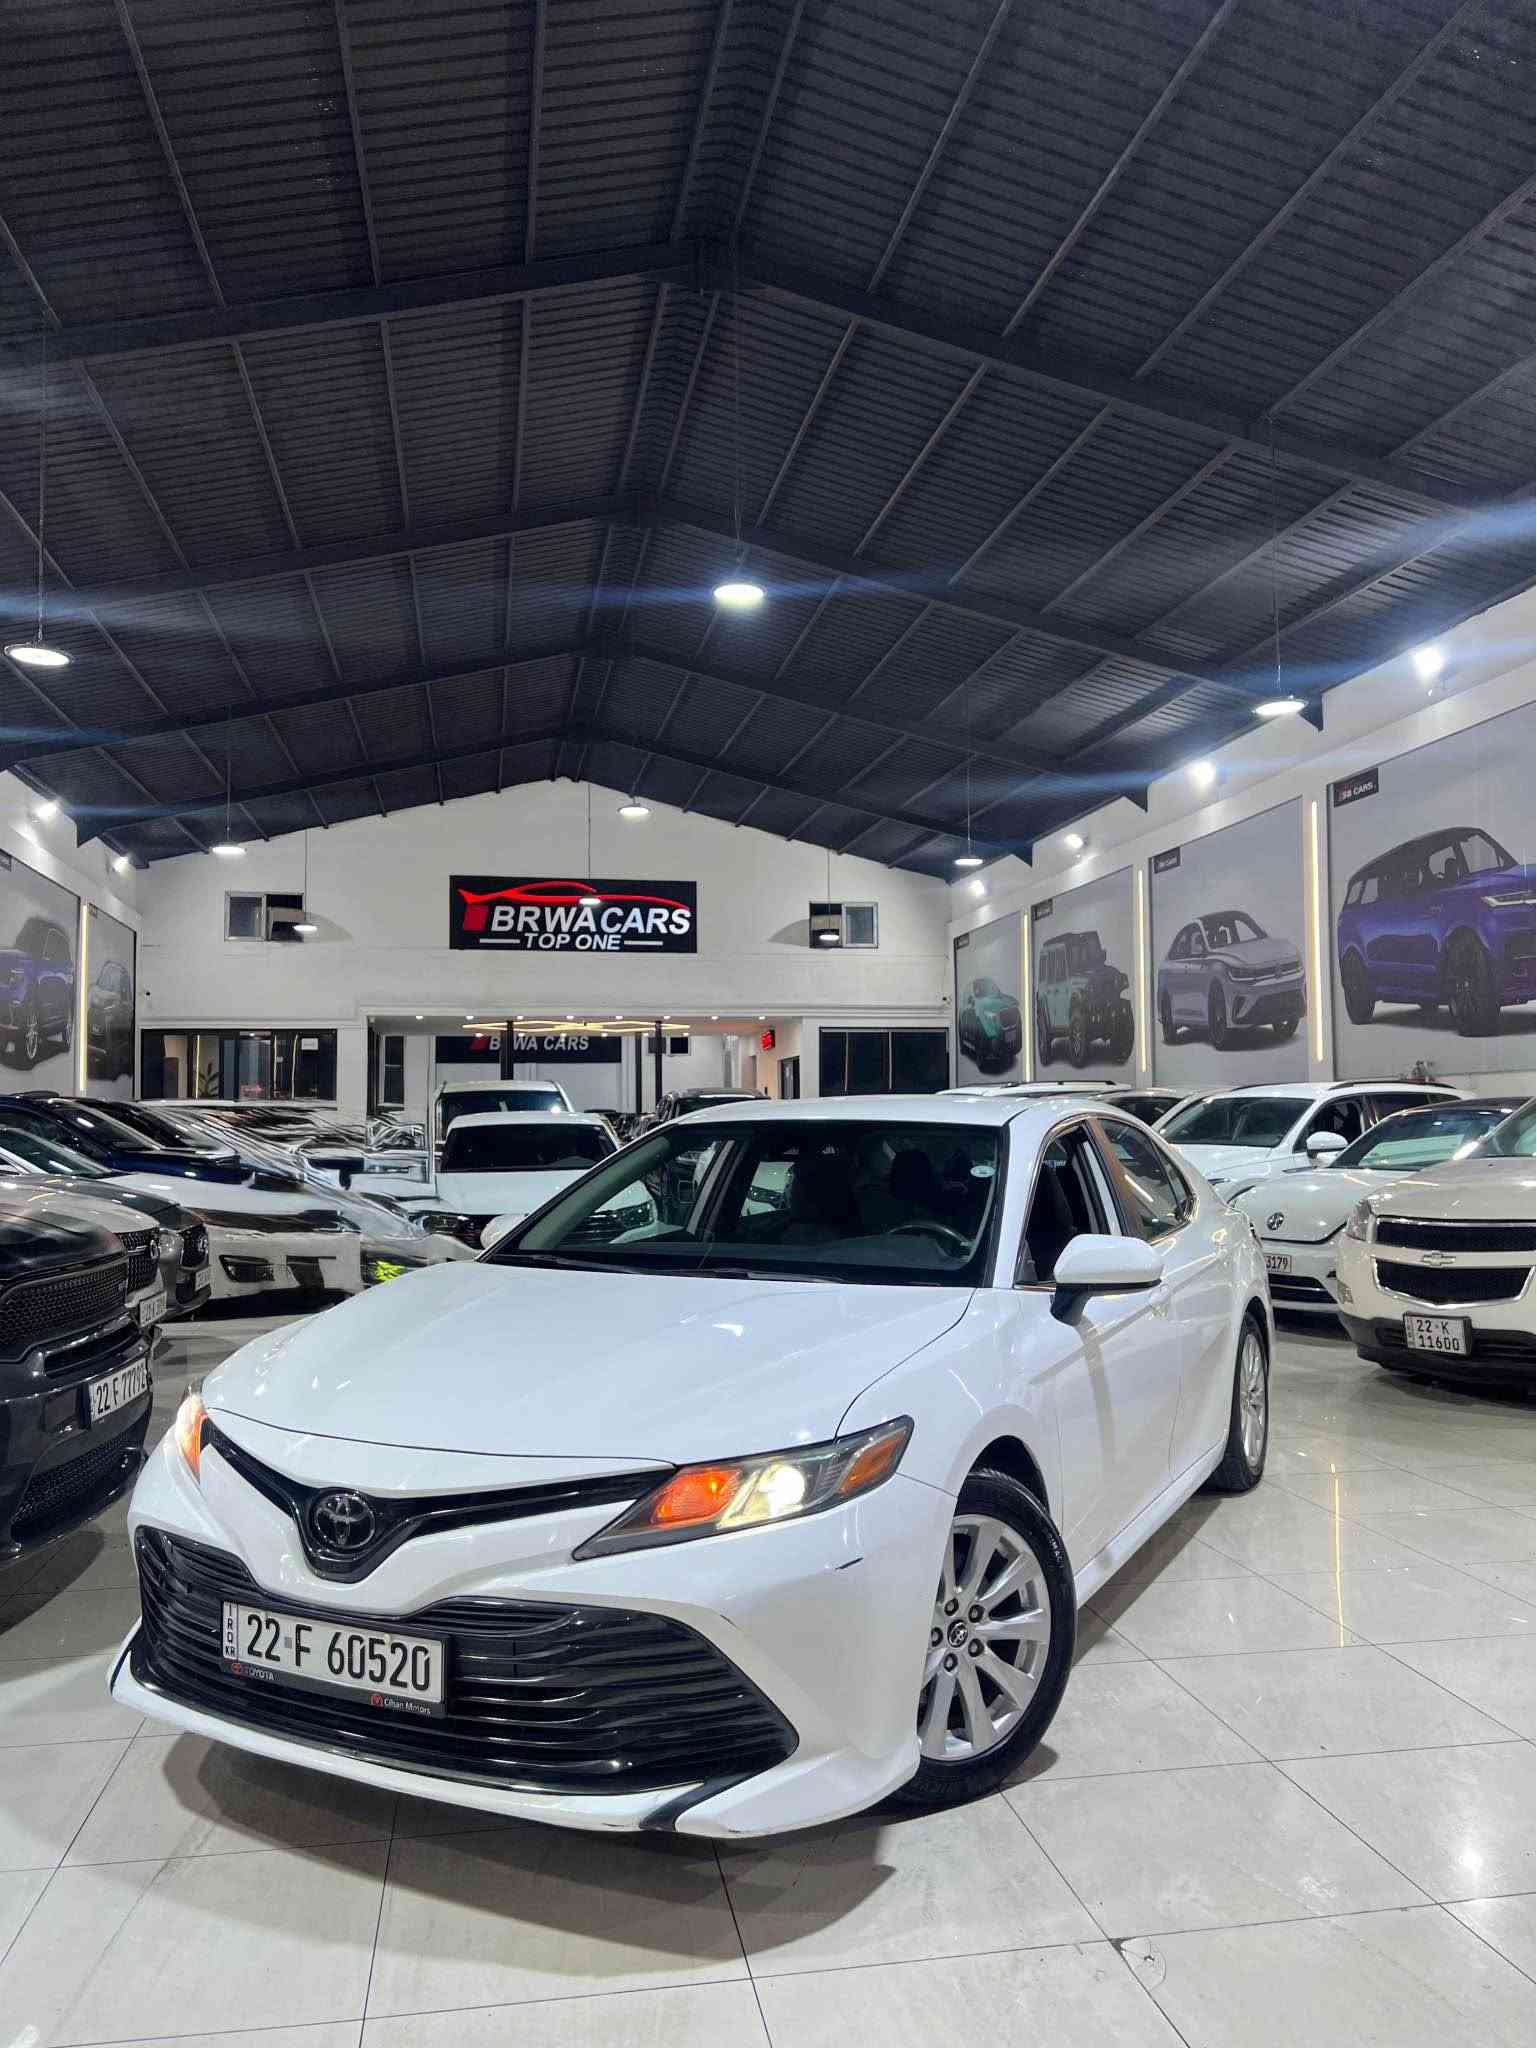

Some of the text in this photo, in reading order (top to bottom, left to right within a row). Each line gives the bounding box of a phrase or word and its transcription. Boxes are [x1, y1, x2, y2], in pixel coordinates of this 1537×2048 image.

[491, 905, 691, 935] BRWA CARS
[525, 933, 622, 951] TOP ONE
[489, 1036, 589, 1051] BWA CARS
[1416, 1319, 1432, 1333] 22
[1441, 1321, 1449, 1335] K
[1418, 1335, 1460, 1351] 11600
[96, 1382, 110, 1413] 22
[113, 1377, 119, 1406] F
[247, 1613, 431, 1691] 22 F 60520
